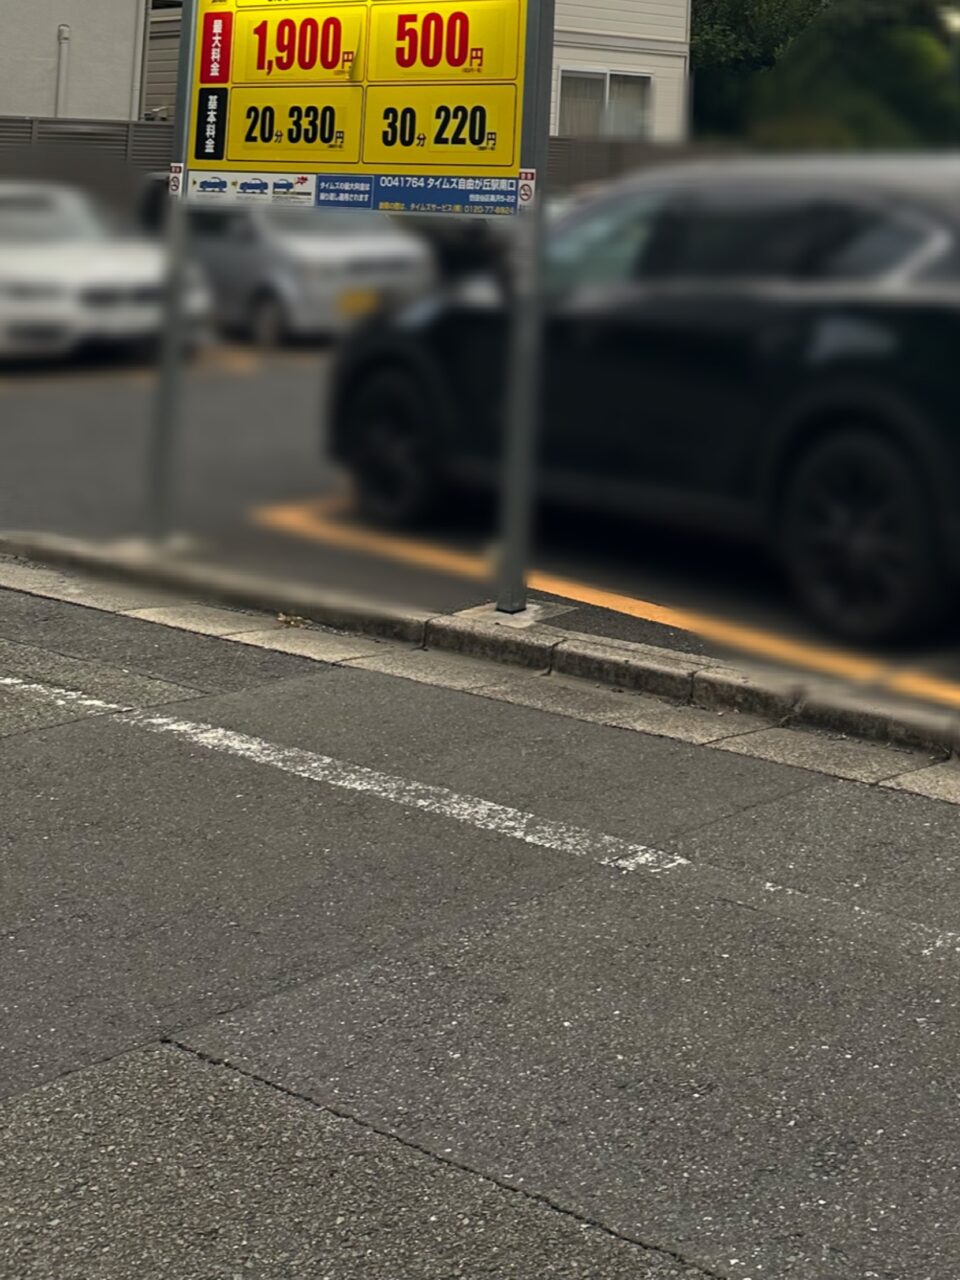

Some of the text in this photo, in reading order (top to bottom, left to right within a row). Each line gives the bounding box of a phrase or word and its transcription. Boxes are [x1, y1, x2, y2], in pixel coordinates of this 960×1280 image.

[208, 19, 224, 77] 最大料金
[253, 16, 355, 76] 1,900円
[395, 11, 484, 68] 500円
[204, 95, 219, 153] 基本料金
[379, 176, 425, 188] 0041764
